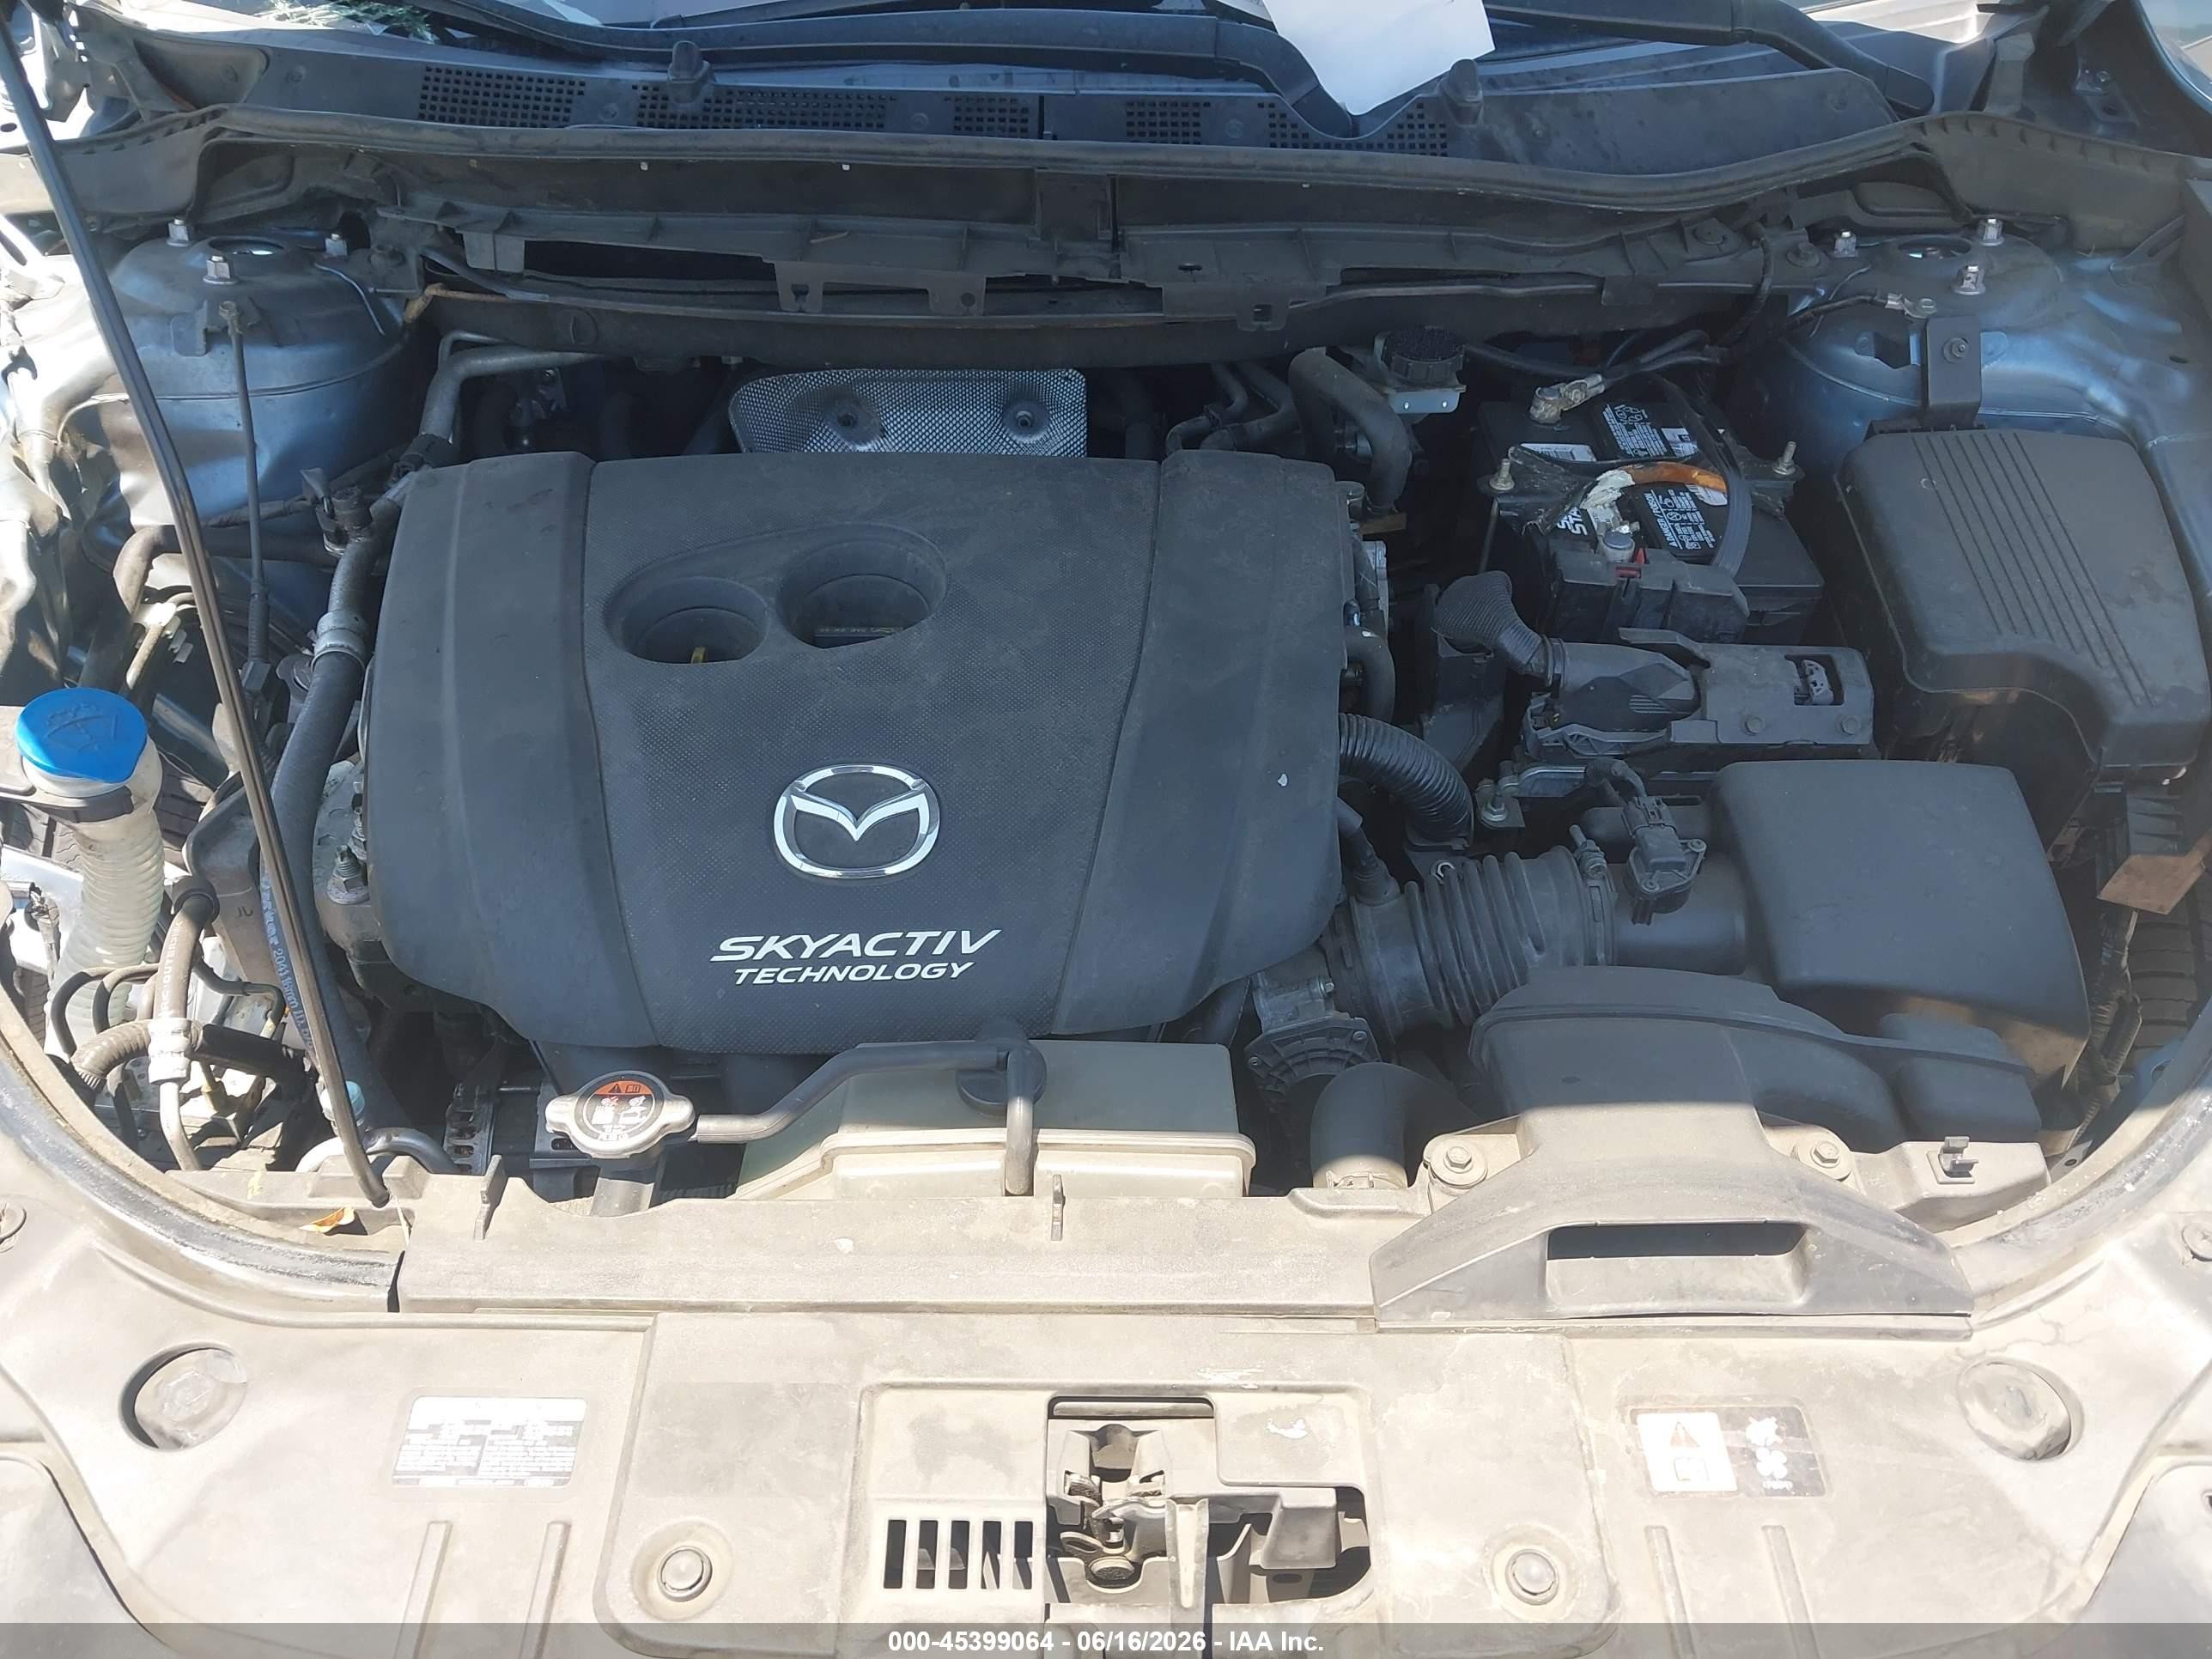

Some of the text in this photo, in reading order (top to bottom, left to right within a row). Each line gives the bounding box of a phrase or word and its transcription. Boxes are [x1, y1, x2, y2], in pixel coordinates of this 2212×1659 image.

[1644, 493, 1662, 514] POISON
[1657, 518, 1676, 542] DANGER
[710, 929, 1002, 962] SKYACTIV
[735, 962, 975, 985] TECHNOLOGY
